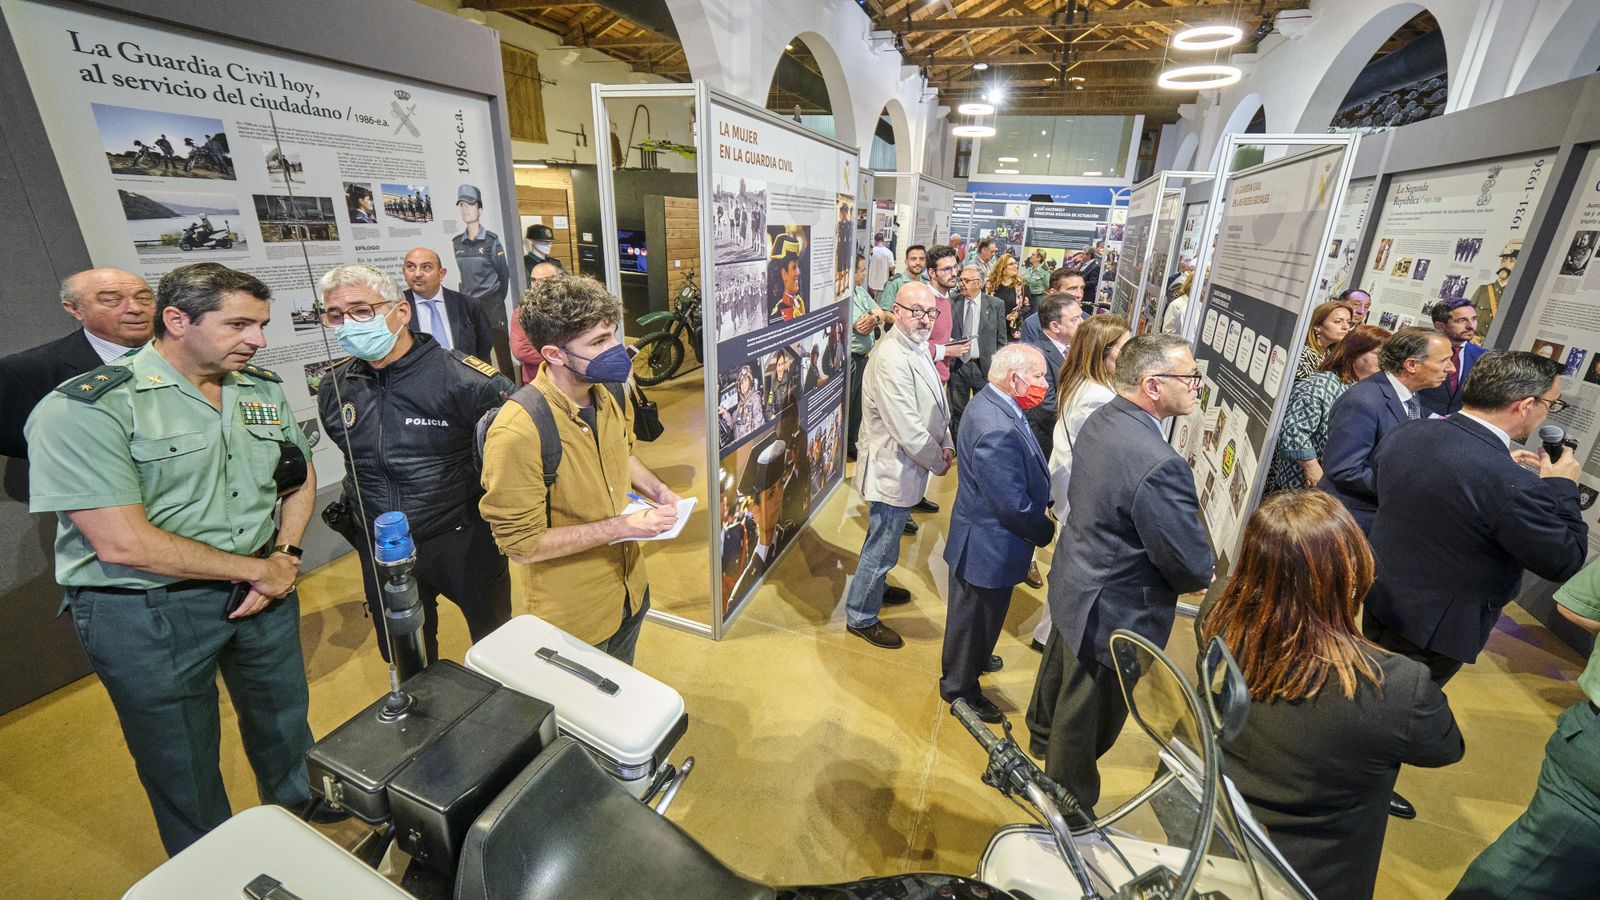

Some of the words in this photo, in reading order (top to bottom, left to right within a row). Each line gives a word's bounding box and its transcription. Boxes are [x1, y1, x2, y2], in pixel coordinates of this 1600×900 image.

[66, 30, 112, 58] La
[117, 41, 222, 79] Guardia
[227, 63, 278, 88] Civil
[280, 73, 320, 99] hoy,
[80, 64, 107, 84] al
[112, 73, 207, 100] servicio
[212, 84, 245, 106] del
[250, 93, 342, 121] ciudadano
[355, 113, 390, 128] 1986-e.a.
[454, 109, 470, 175] 1986-e.a.
[719, 121, 730, 138] LA
[732, 125, 758, 146] MUJER
[719, 144, 731, 160] EN
[733, 148, 743, 163] LA
[745, 151, 778, 170] GUARDIA
[778, 159, 794, 173] CIVIL
[1397, 184, 1405, 195] La
[1405, 181, 1429, 196] Segunda
[1510, 159, 1545, 232] 1931-1936
[405, 418, 449, 427] POLICIA
